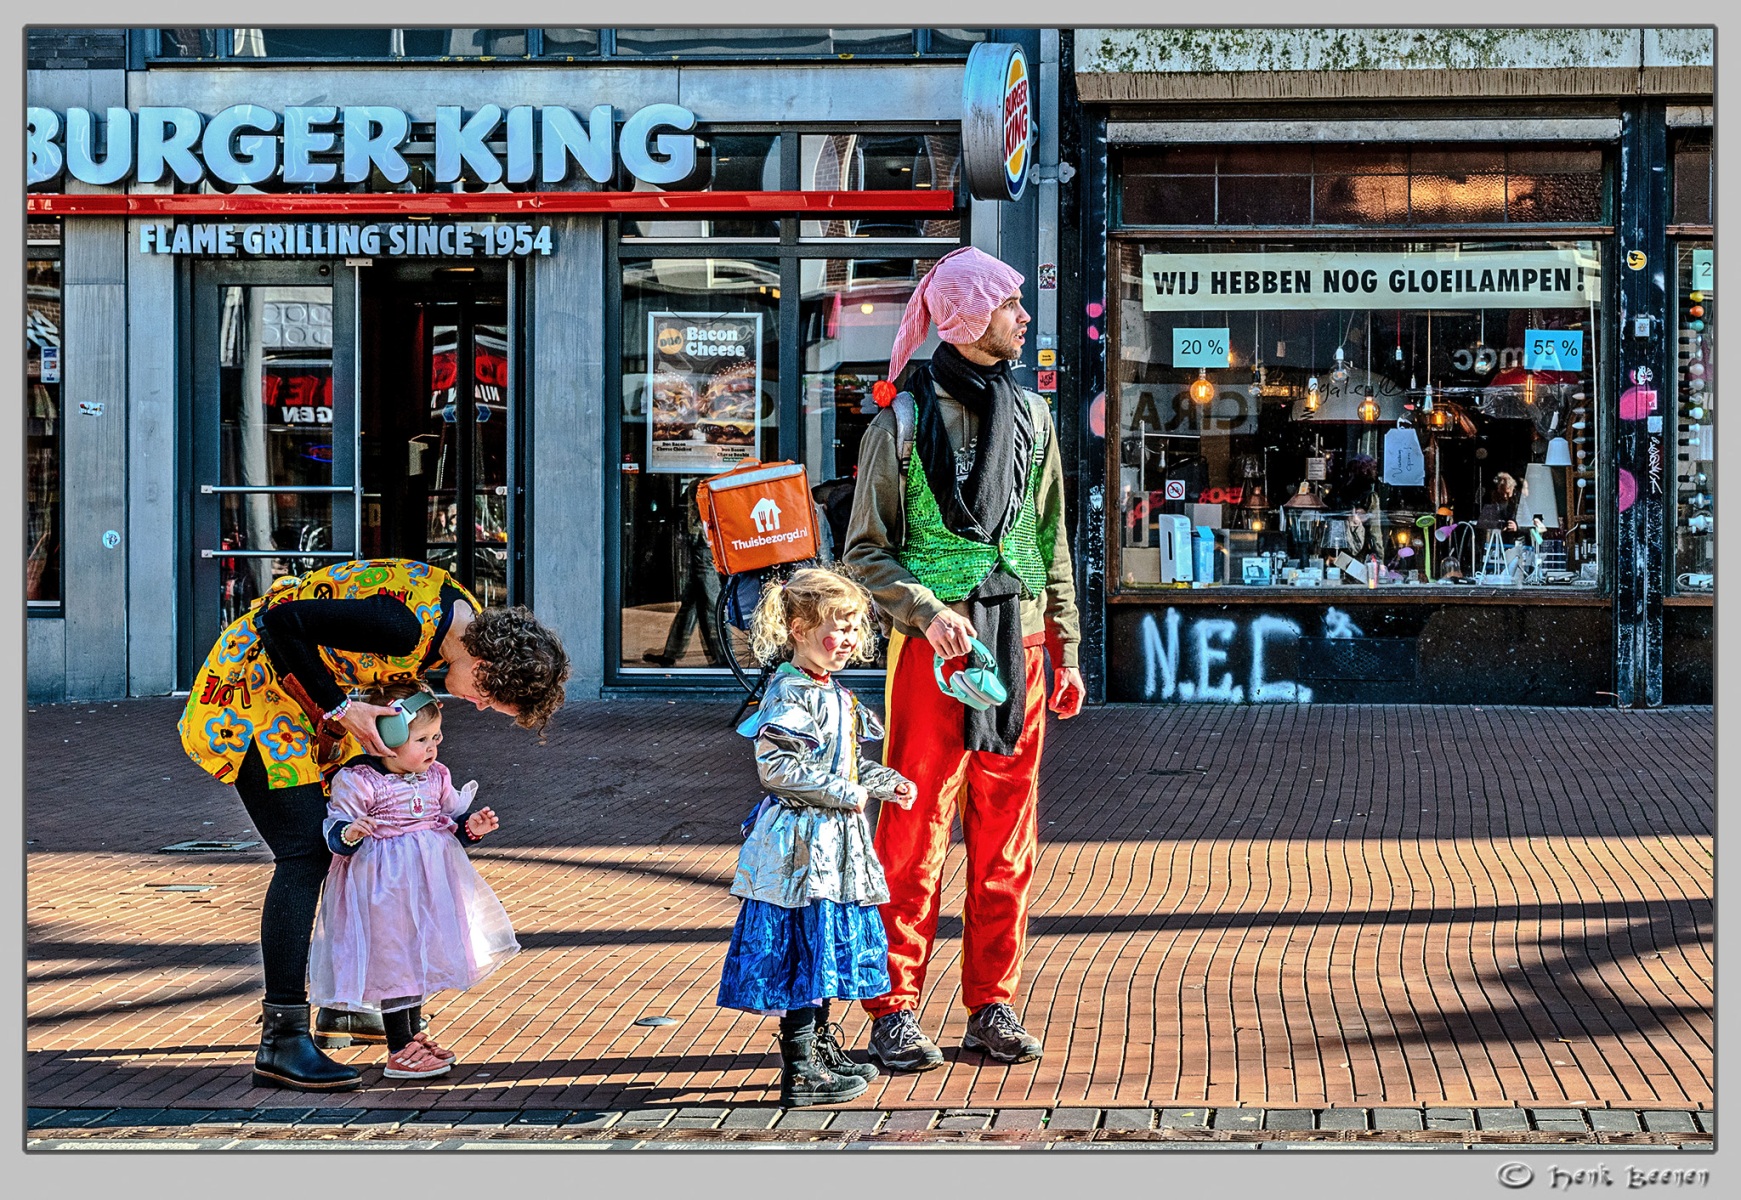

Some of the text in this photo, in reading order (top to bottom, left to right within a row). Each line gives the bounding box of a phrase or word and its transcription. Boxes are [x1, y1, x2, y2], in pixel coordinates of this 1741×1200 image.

[1004, 79, 1028, 125] BURGER
[435, 103, 698, 185] KING
[1004, 104, 1028, 162] KING
[139, 223, 553, 257] FLAME GRILLING SINCE 1954
[1153, 266, 1585, 295] WIJ HEBBEN NOG GLOEILAMPEN!
[686, 326, 738, 341] Bacon
[685, 341, 746, 357] Cheese
[1180, 339, 1225, 356] 20 %
[1533, 339, 1579, 357] 55 %
[731, 527, 809, 551] Thuisbezorgd.nl
